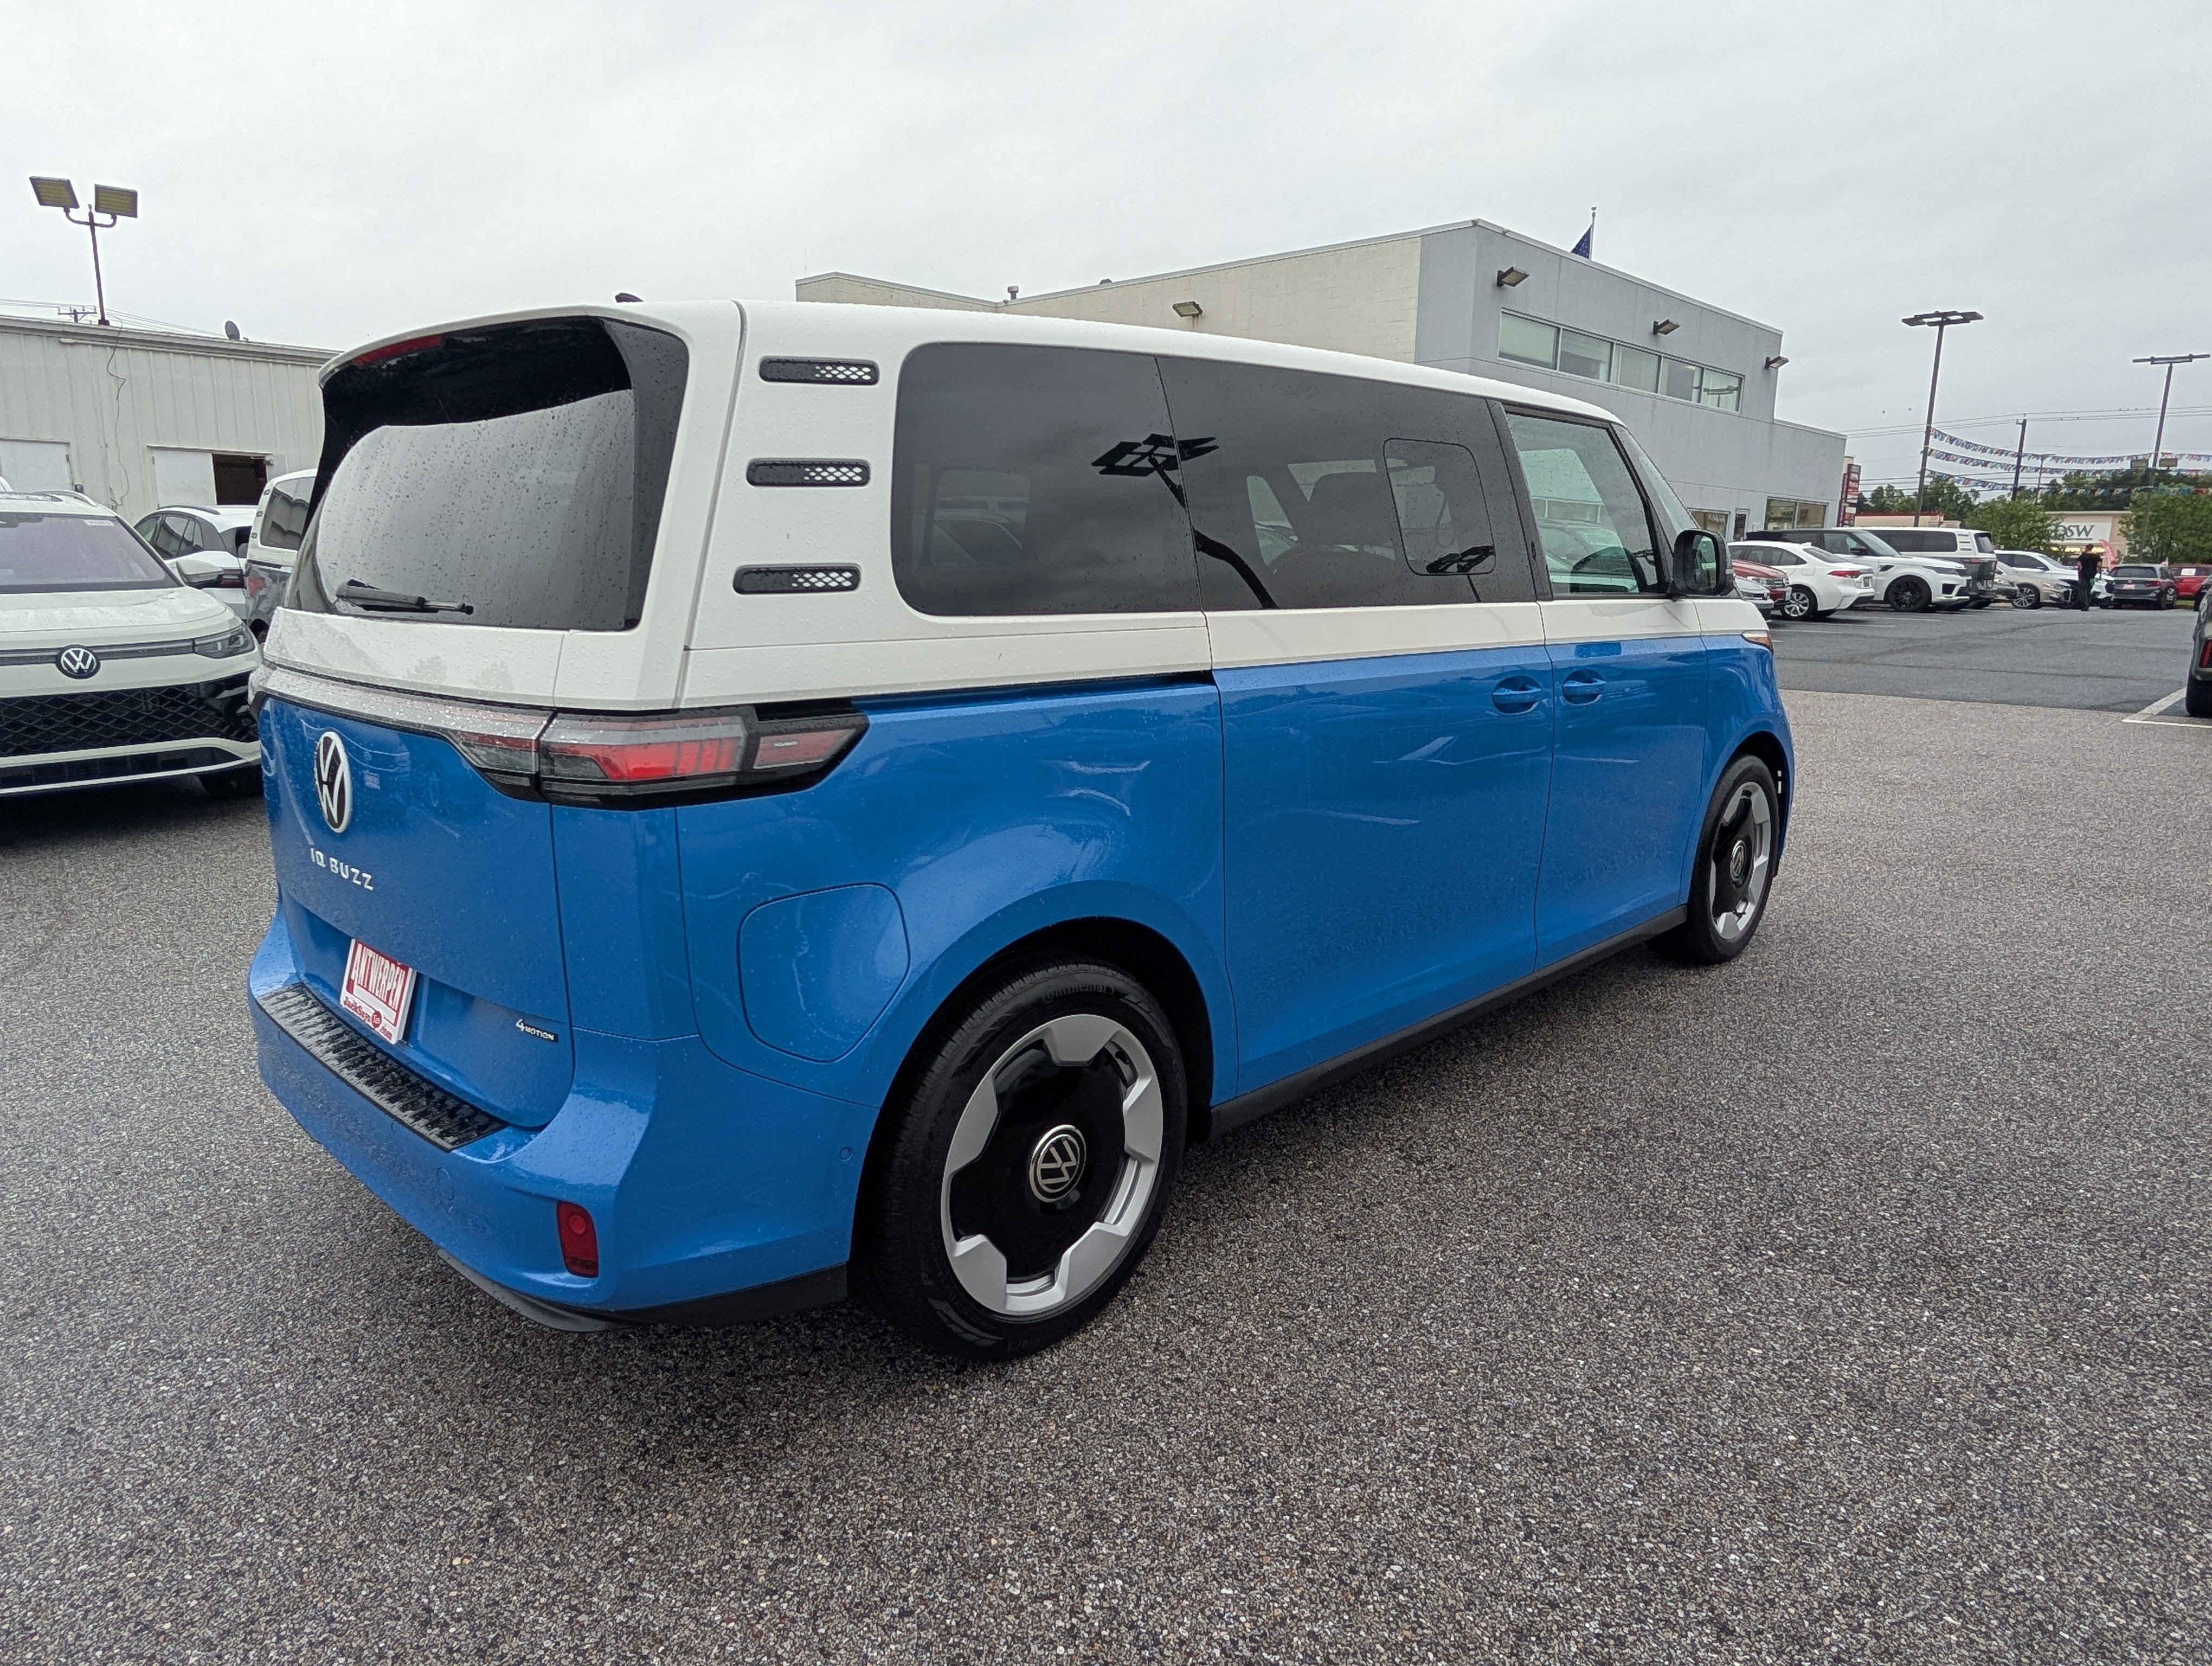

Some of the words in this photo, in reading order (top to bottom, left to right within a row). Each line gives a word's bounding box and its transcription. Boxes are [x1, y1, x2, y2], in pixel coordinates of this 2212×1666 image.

[2055, 524, 2094, 537] DSW
[61, 648, 97, 675] VW
[329, 857, 374, 890] BUZZ
[351, 943, 406, 1011] ANTWERPEN
[516, 1018, 555, 1041] 4MOTION
